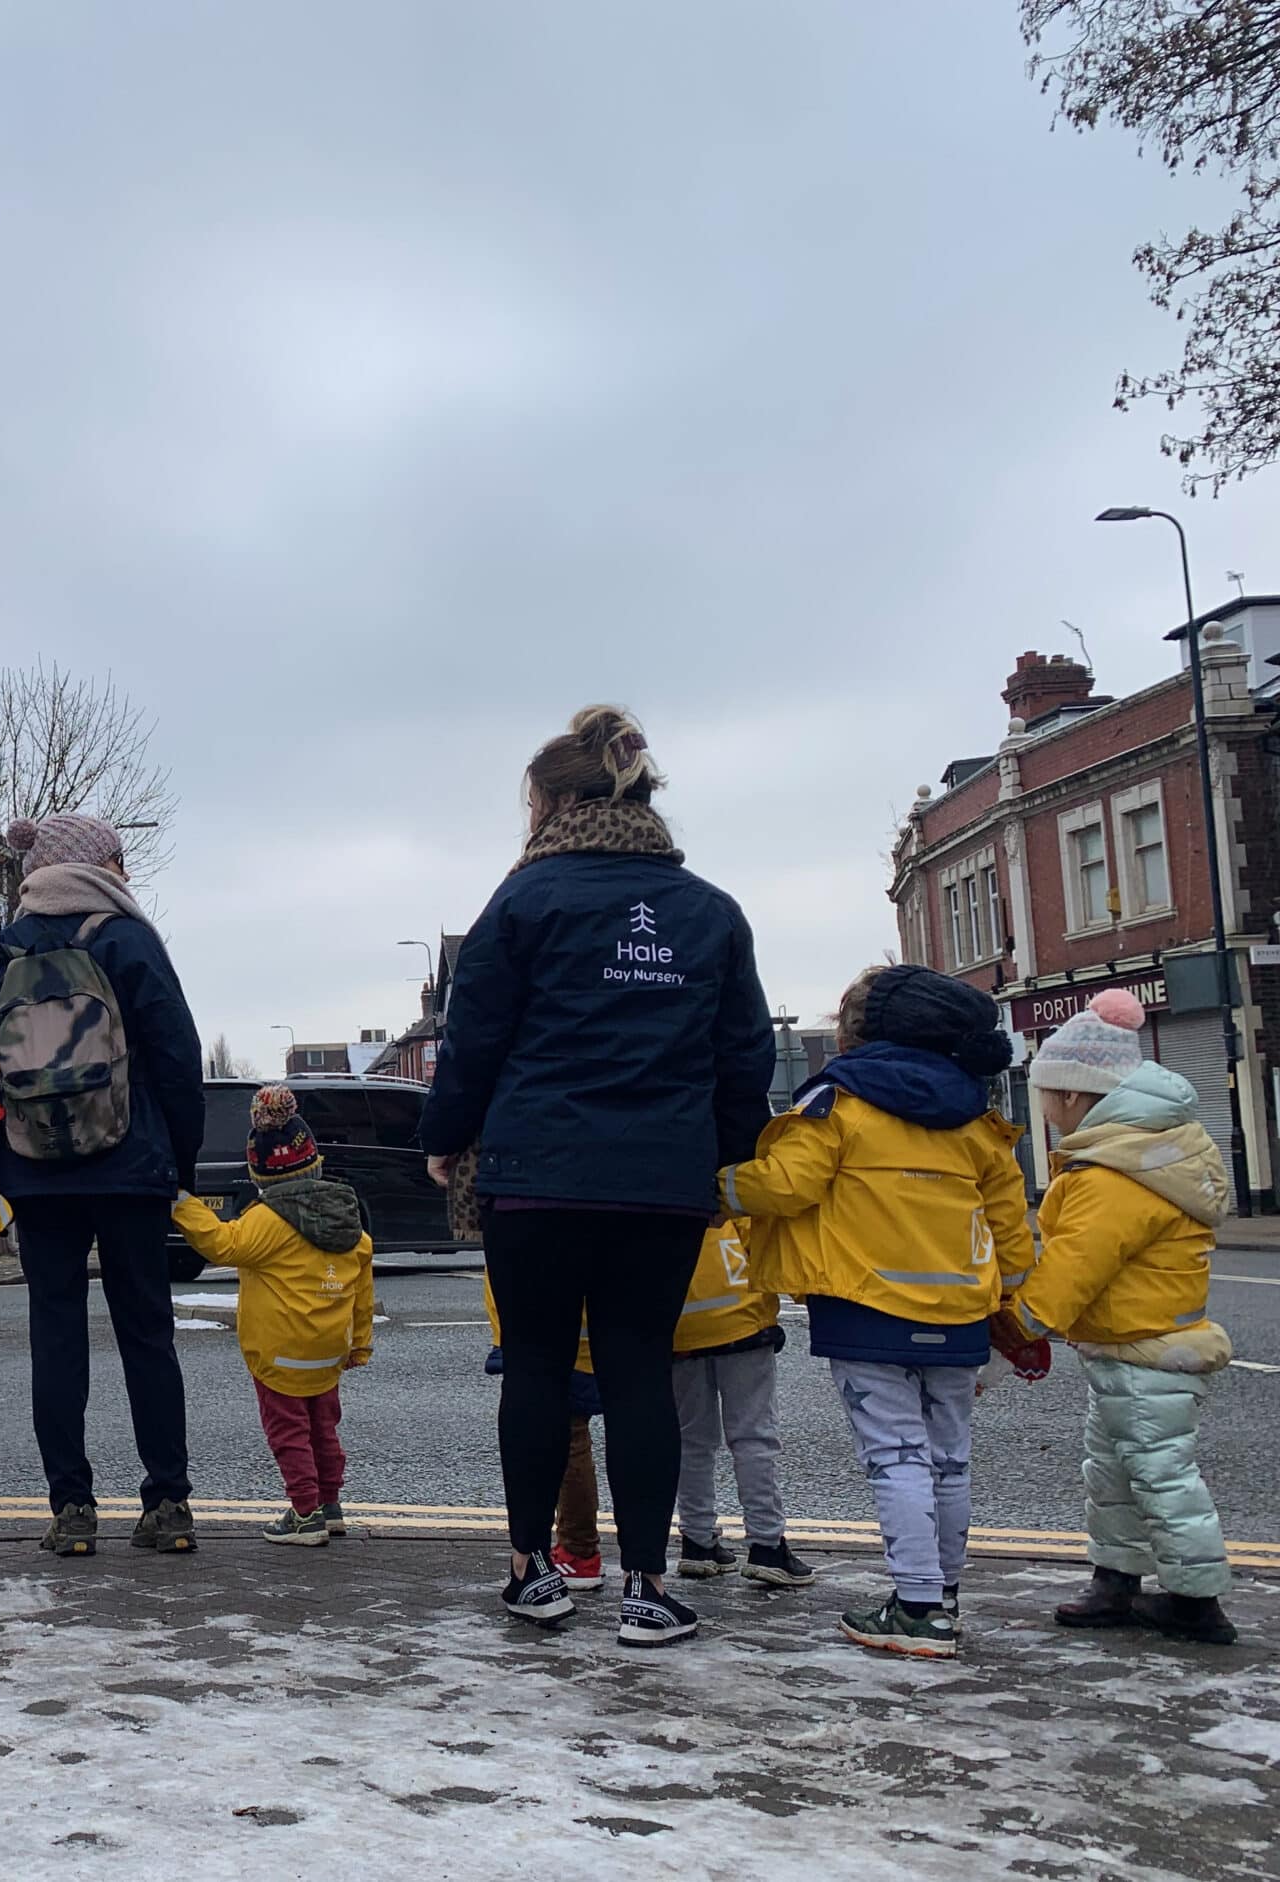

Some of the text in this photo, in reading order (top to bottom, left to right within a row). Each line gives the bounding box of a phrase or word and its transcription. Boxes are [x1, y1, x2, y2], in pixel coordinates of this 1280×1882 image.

[617, 940, 673, 963] Hale
[603, 967, 685, 985] Day Nursery
[1033, 992, 1099, 1022] PORTLA
